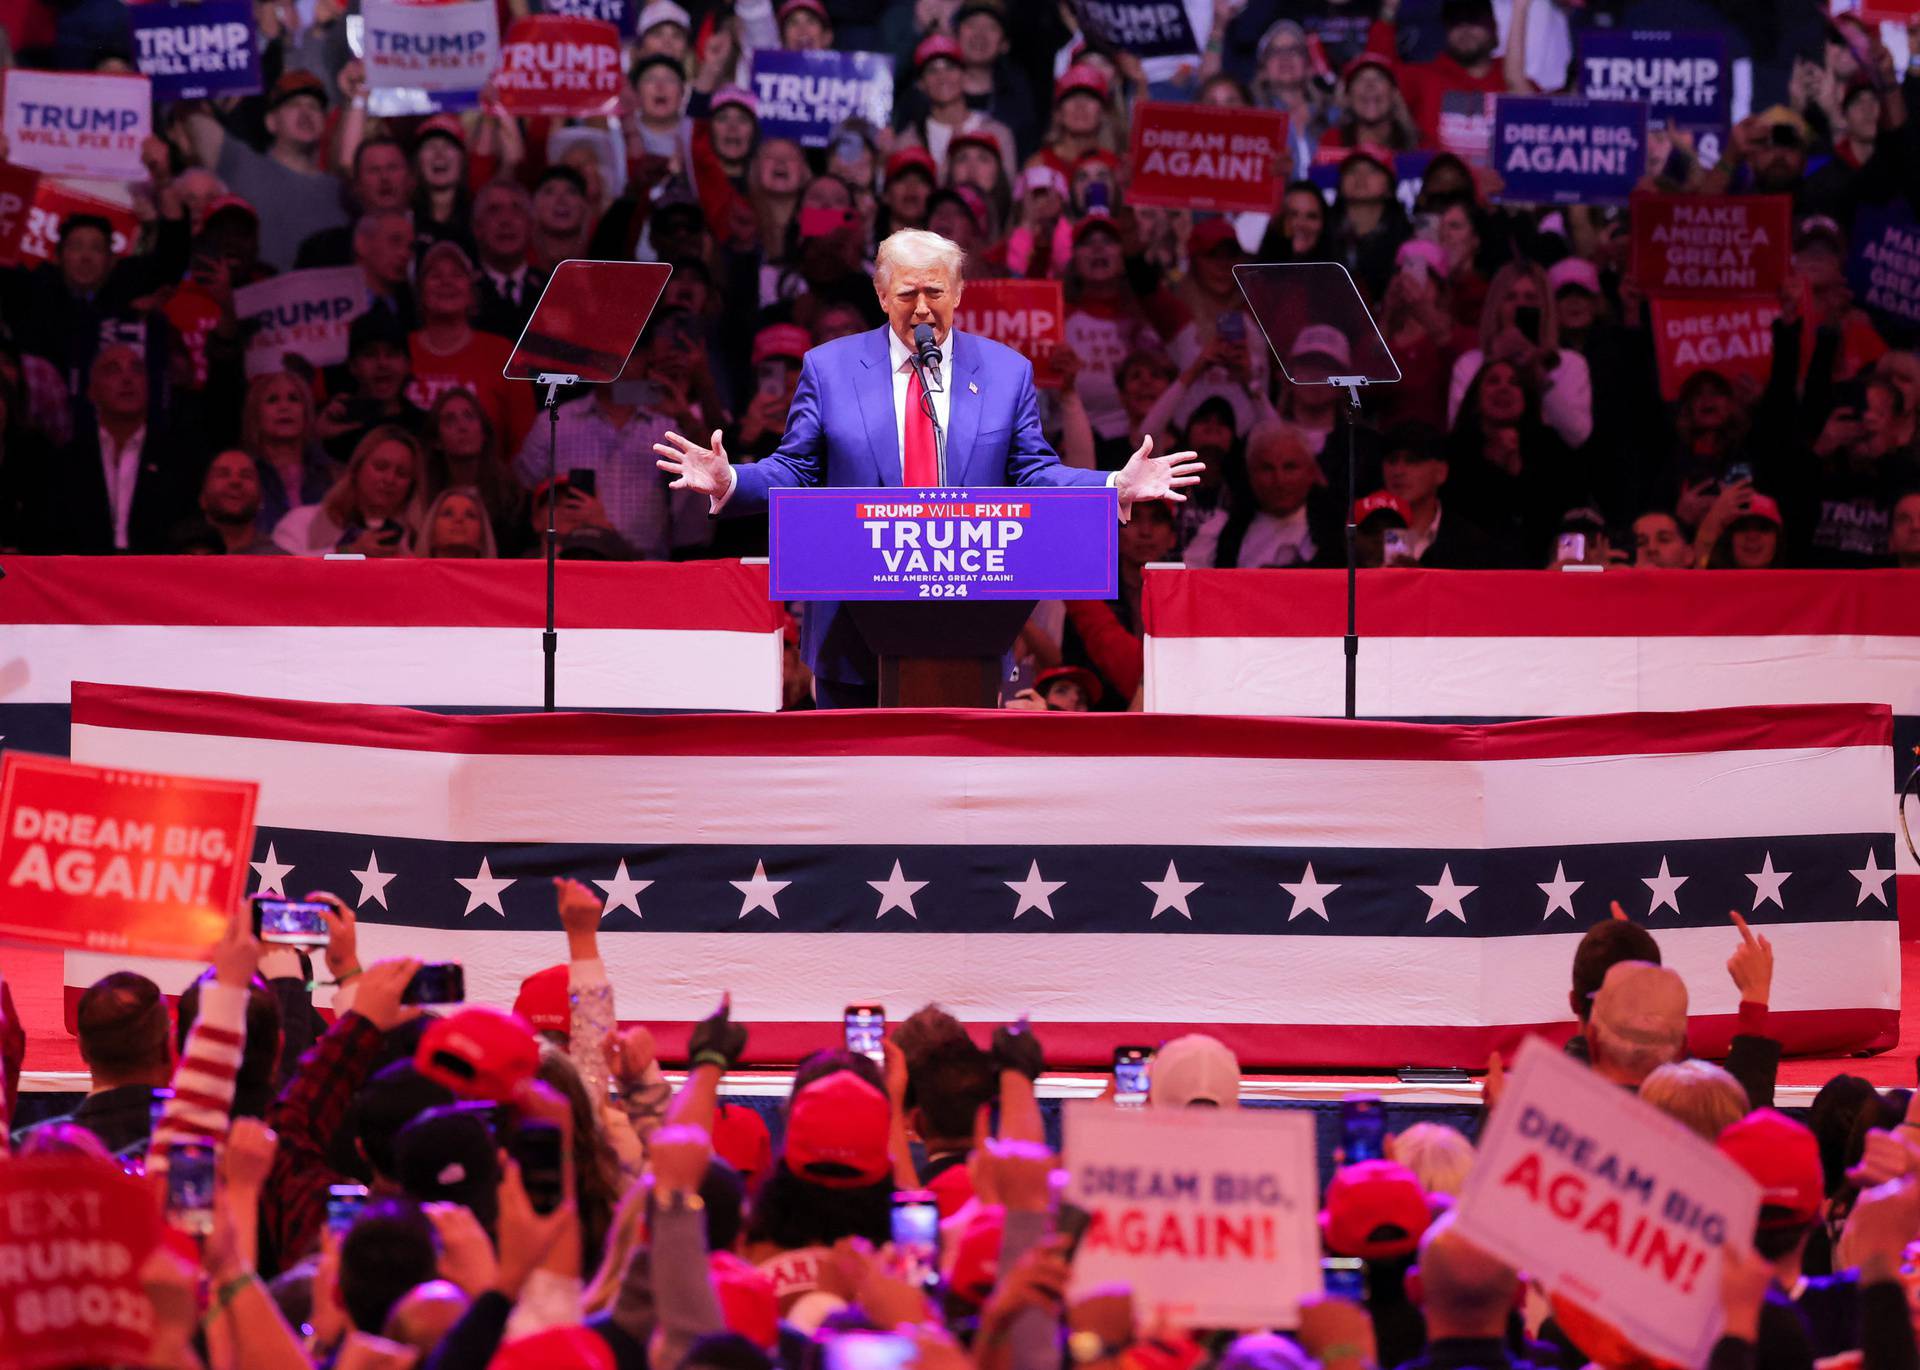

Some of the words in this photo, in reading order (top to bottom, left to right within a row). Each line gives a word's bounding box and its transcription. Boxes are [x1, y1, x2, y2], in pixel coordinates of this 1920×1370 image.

[134, 22, 249, 57] TRUMP
[371, 29, 486, 54] TRUMP
[500, 42, 618, 70] TRUMP
[1584, 56, 1719, 88] TRUMP
[1649, 86, 1690, 107] FIX
[1692, 84, 1718, 106] IT
[18, 102, 139, 132] TRUMP
[1141, 128, 1226, 151] DREAM
[1504, 123, 1589, 145] DREAM
[1590, 126, 1639, 150] BIG,
[1140, 149, 1265, 183] AGAIN!
[1505, 146, 1628, 174] AGAIN!
[1673, 205, 1747, 224] MAKE
[1651, 224, 1768, 246] AMERICA
[1666, 245, 1754, 267] GREAT
[1663, 267, 1756, 288] AGAIN!
[1666, 312, 1751, 339] DREAM
[1031, 337, 1056, 358] IT
[864, 504, 923, 518] TRUMP
[928, 504, 970, 518] WILL
[975, 504, 1003, 518] FIX
[1007, 504, 1023, 518] IT
[863, 520, 1024, 549] TRUMP
[881, 550, 1006, 573] VANCE
[873, 574, 900, 582] MAKE
[902, 574, 945, 582] AMERICA
[947, 574, 978, 582] GREAT
[980, 574, 1014, 582] AGAIN!
[918, 584, 968, 597] 2024
[12, 805, 155, 850] DREAM
[163, 825, 234, 868] BIG,
[8, 844, 216, 905] AGAIN!
[1516, 1105, 1656, 1204] DREAM
[1081, 1165, 1200, 1200] DREAM
[1213, 1173, 1294, 1211] BIG,
[1086, 1207, 1279, 1262] AGAIN!
[1502, 1152, 1707, 1294] AGAIN!
